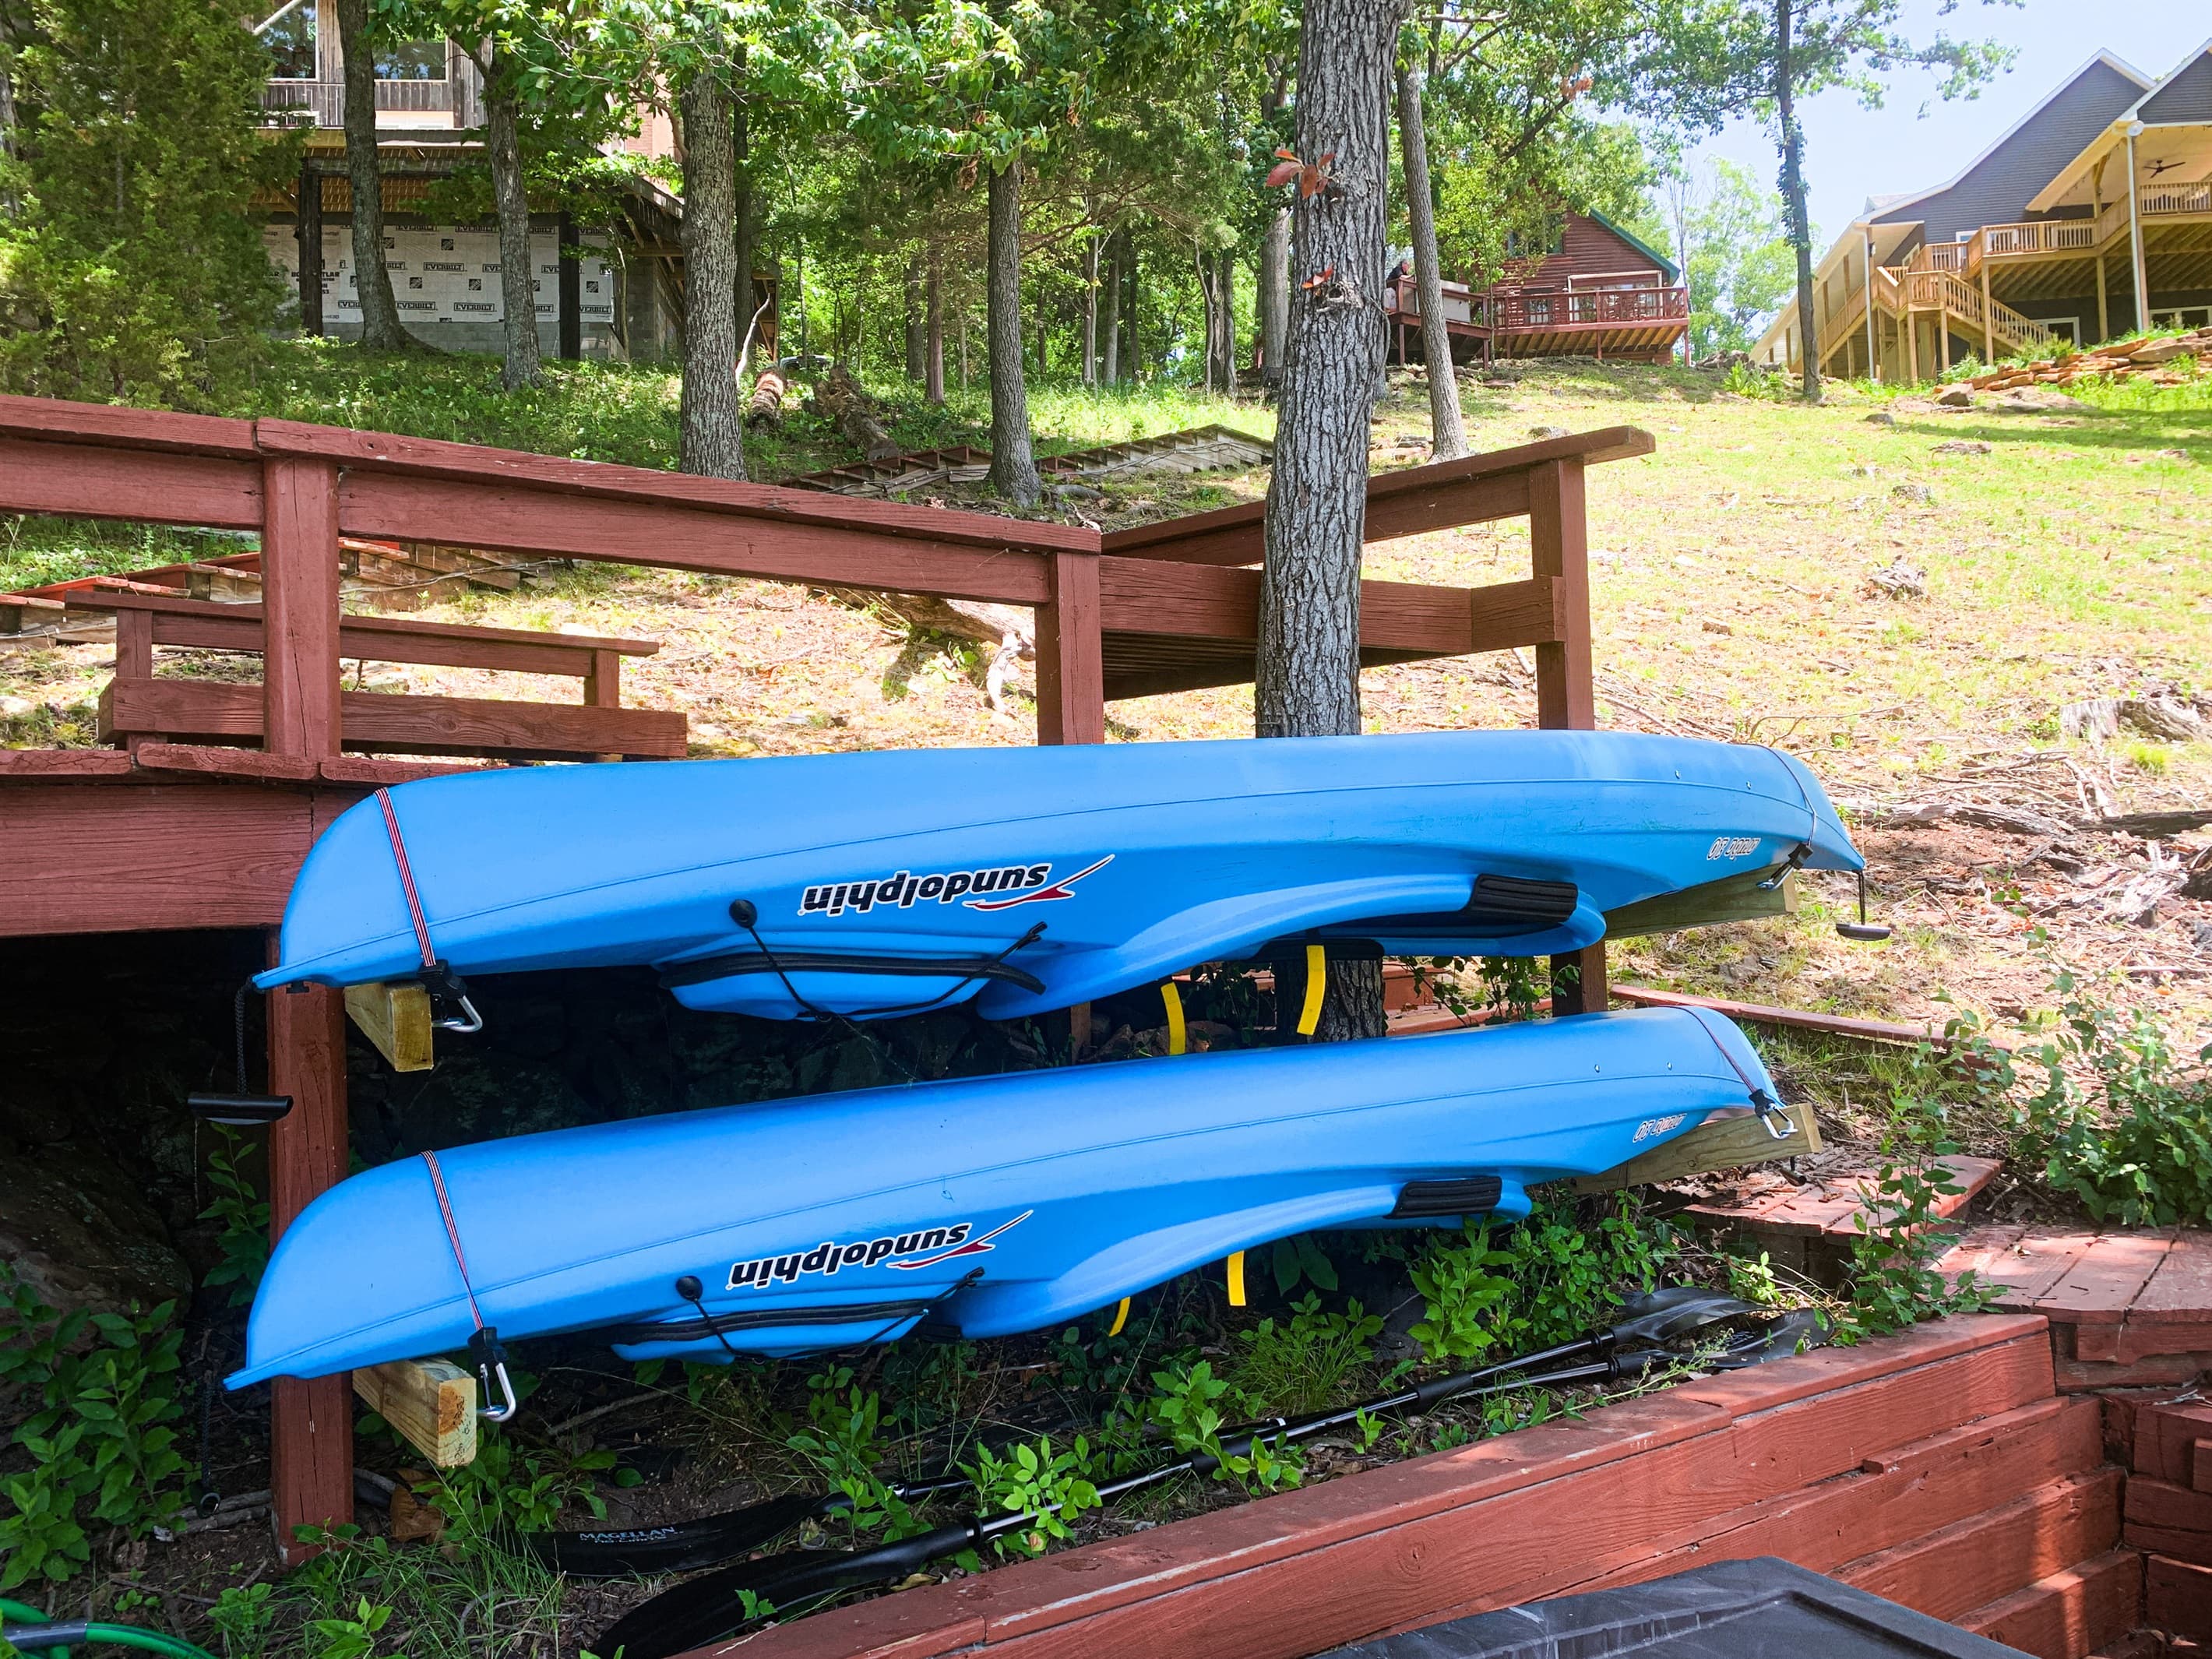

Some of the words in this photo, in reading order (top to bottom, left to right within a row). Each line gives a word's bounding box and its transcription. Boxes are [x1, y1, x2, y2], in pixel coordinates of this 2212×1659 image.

[802, 862, 1051, 916] sundolphin
[729, 1222, 973, 1290] sundolphin
[579, 1527, 676, 1540] MAGELLAN
